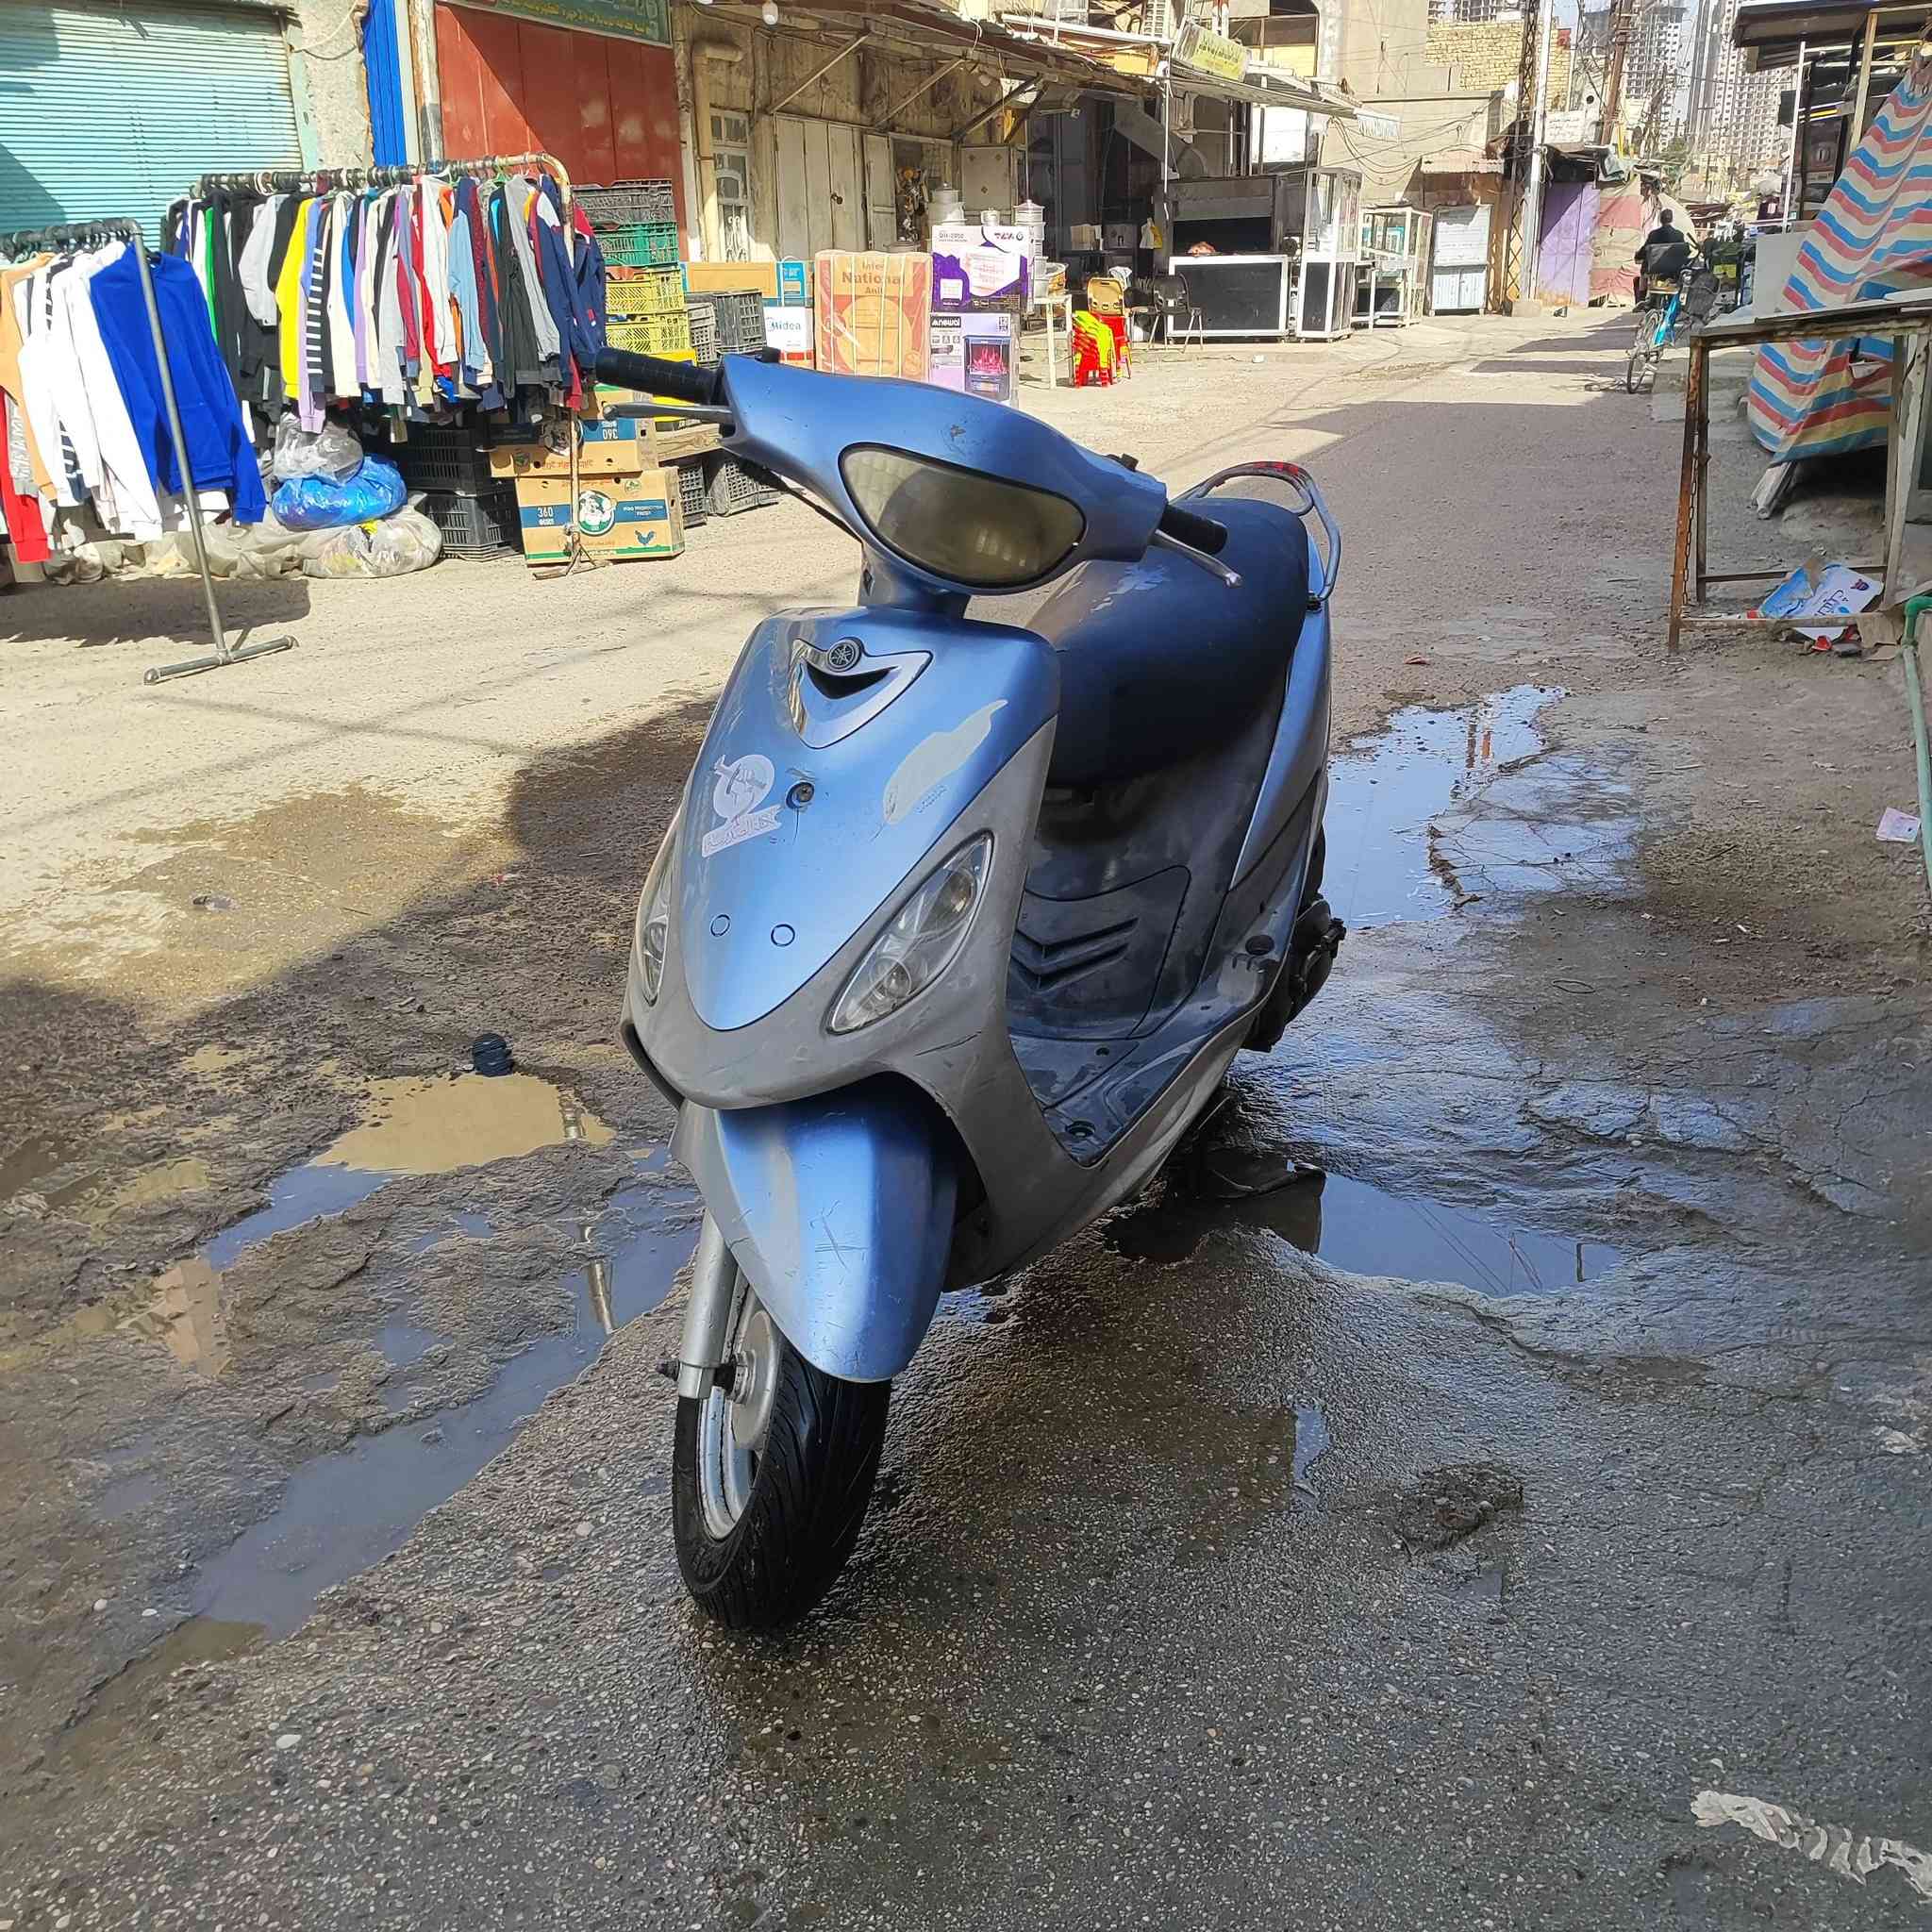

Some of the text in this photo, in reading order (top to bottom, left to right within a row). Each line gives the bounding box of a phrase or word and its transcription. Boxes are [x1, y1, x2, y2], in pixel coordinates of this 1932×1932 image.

[771, 320, 801, 330] Midea
[603, 428, 618, 441] 360
[537, 507, 553, 518] 360
